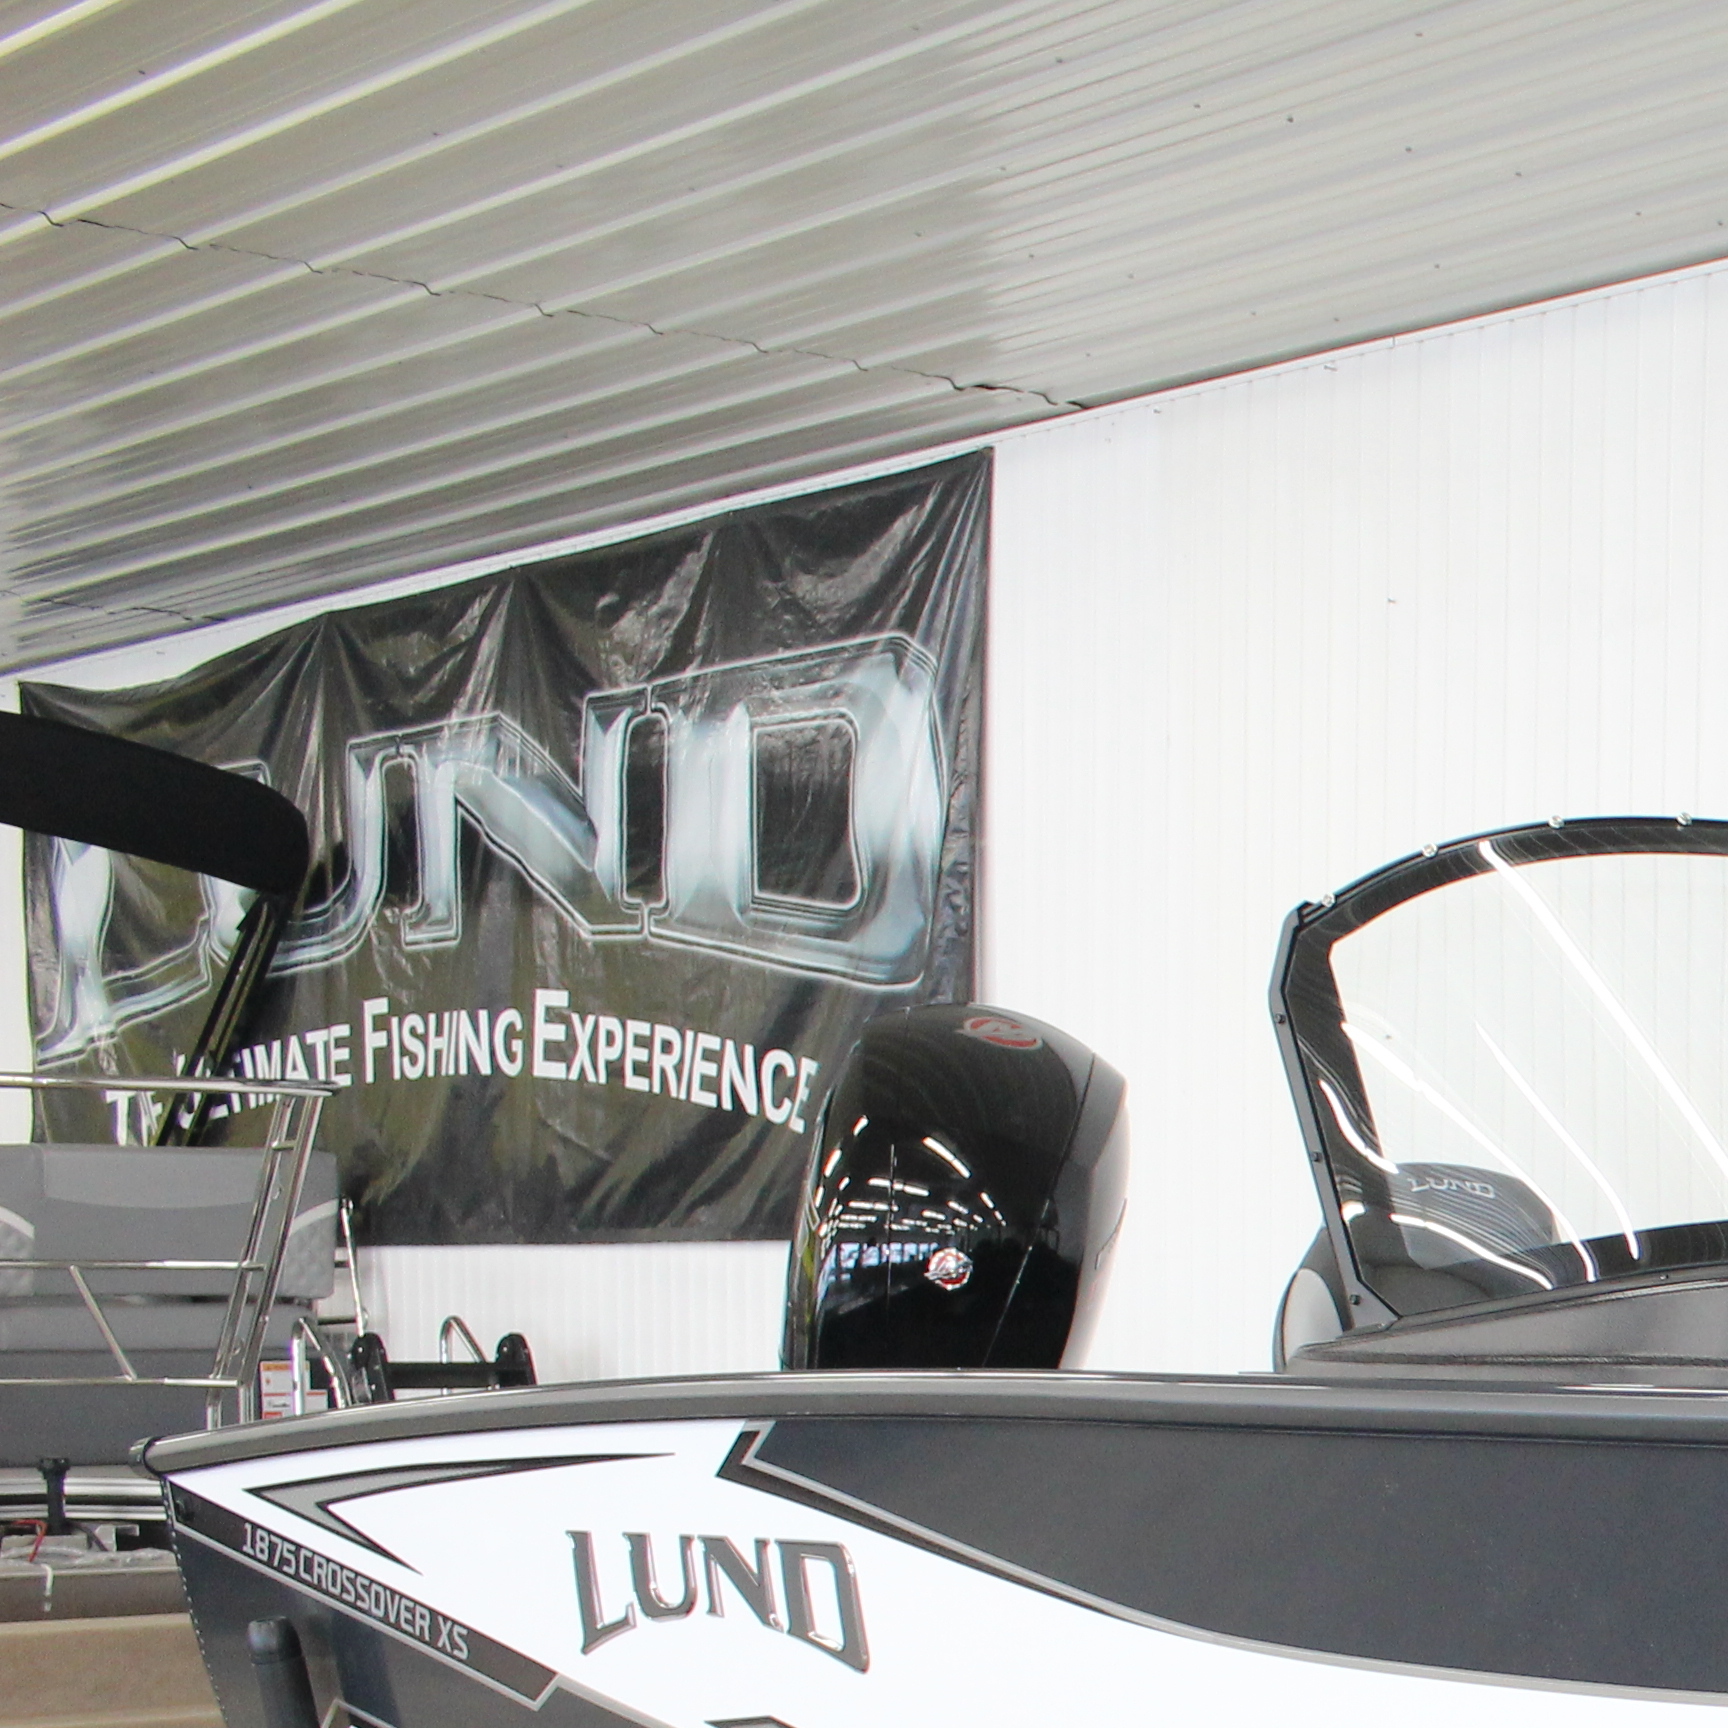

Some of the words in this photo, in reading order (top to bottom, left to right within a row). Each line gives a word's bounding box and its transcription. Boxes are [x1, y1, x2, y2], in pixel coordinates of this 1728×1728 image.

[363, 997, 524, 1084] FISHING
[532, 988, 820, 1134] EXPERIENCE
[1407, 1176, 1496, 1199] LUND
[243, 1523, 297, 1575] 1875
[300, 1548, 431, 1641] CROSSOVER
[437, 1615, 468, 1660] XS
[565, 1530, 870, 1674] LUND
